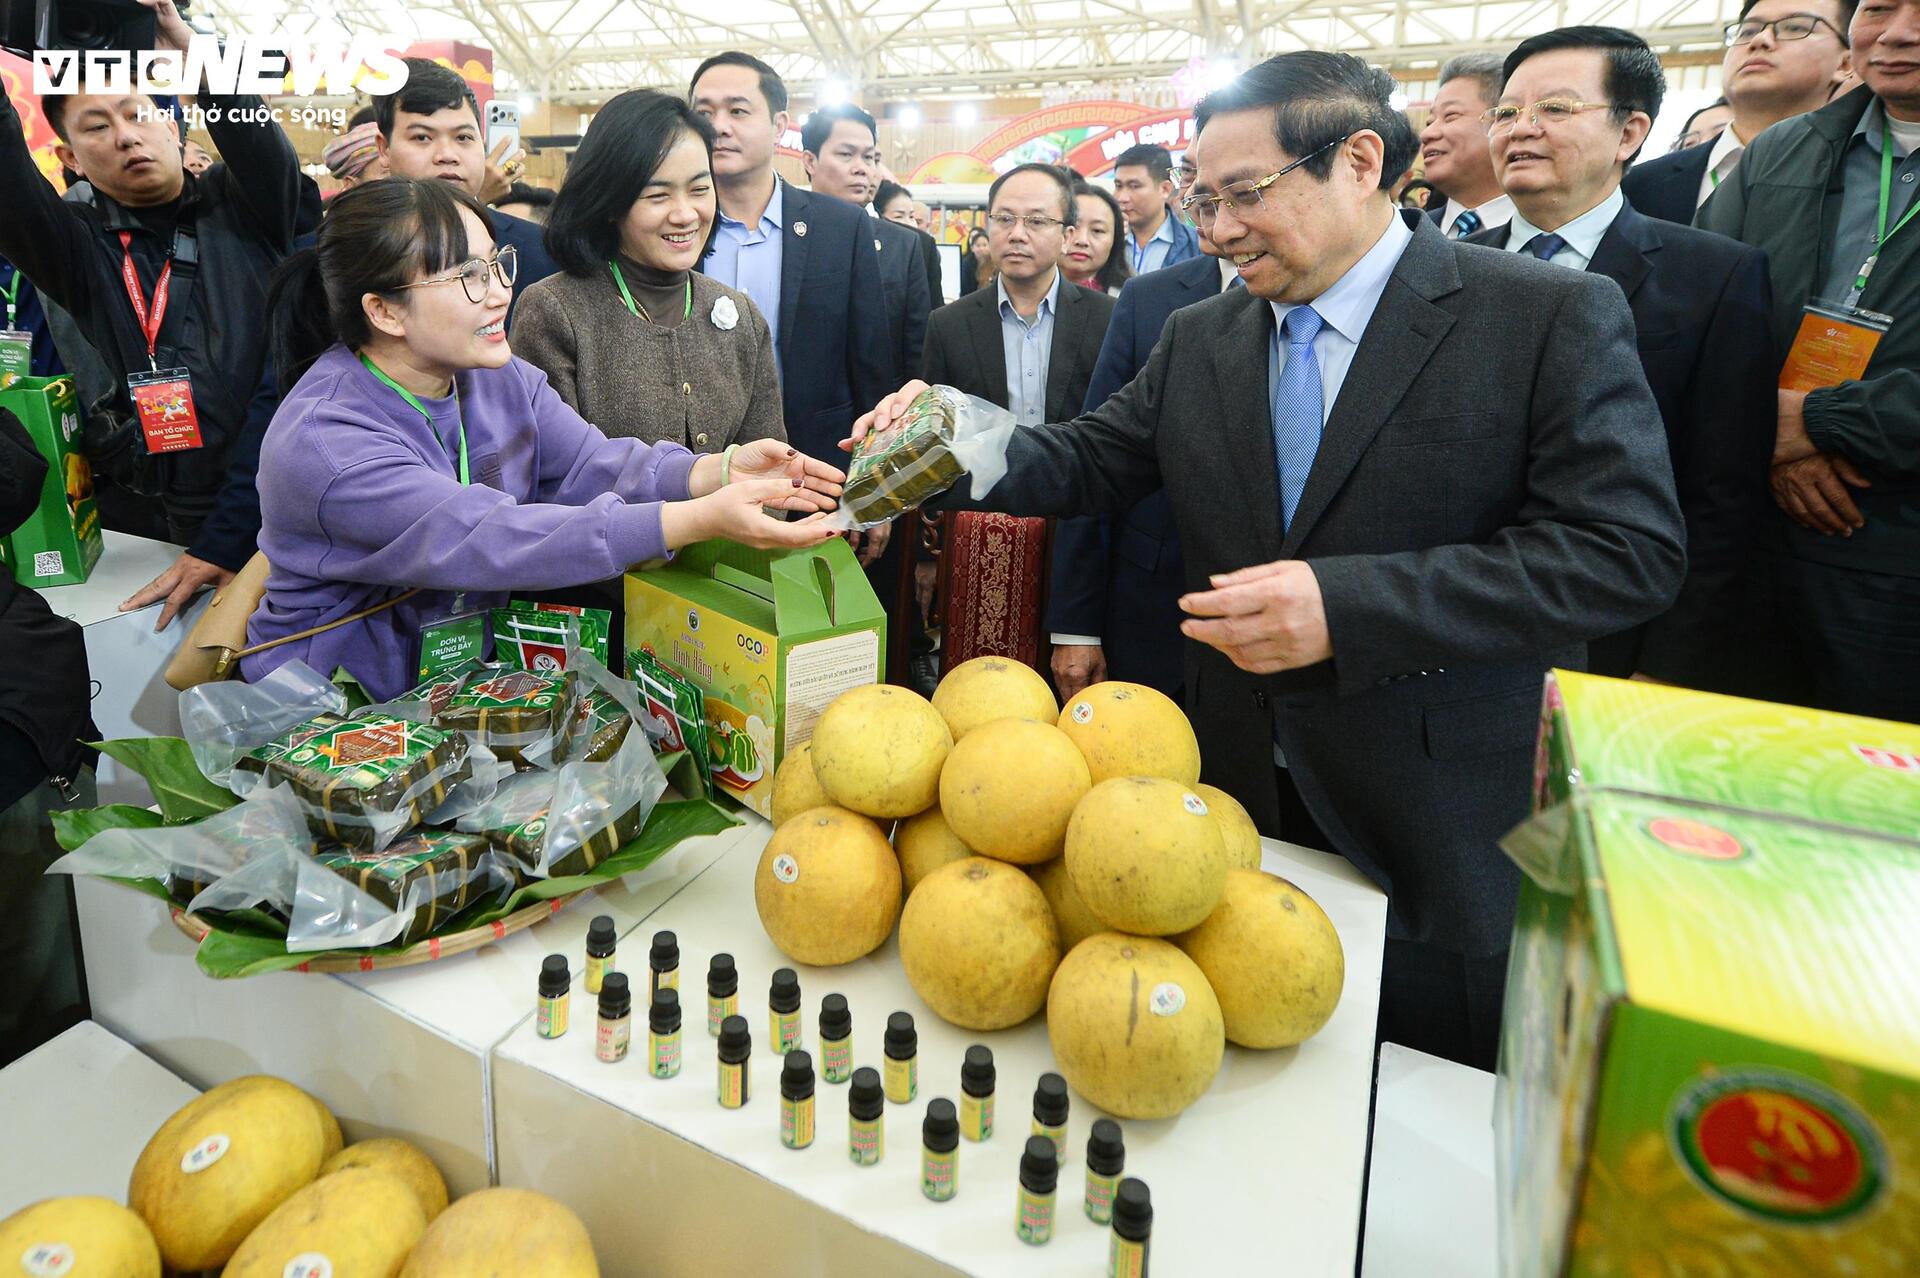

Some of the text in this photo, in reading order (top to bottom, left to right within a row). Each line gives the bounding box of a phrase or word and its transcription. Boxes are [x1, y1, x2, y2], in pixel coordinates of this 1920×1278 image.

[149, 425, 195, 437] BAN TỔ CHỨC
[440, 637, 456, 646] ĐƠN
[737, 633, 769, 657] OCOP
[431, 641, 472, 656] TRƯNG BÀY
